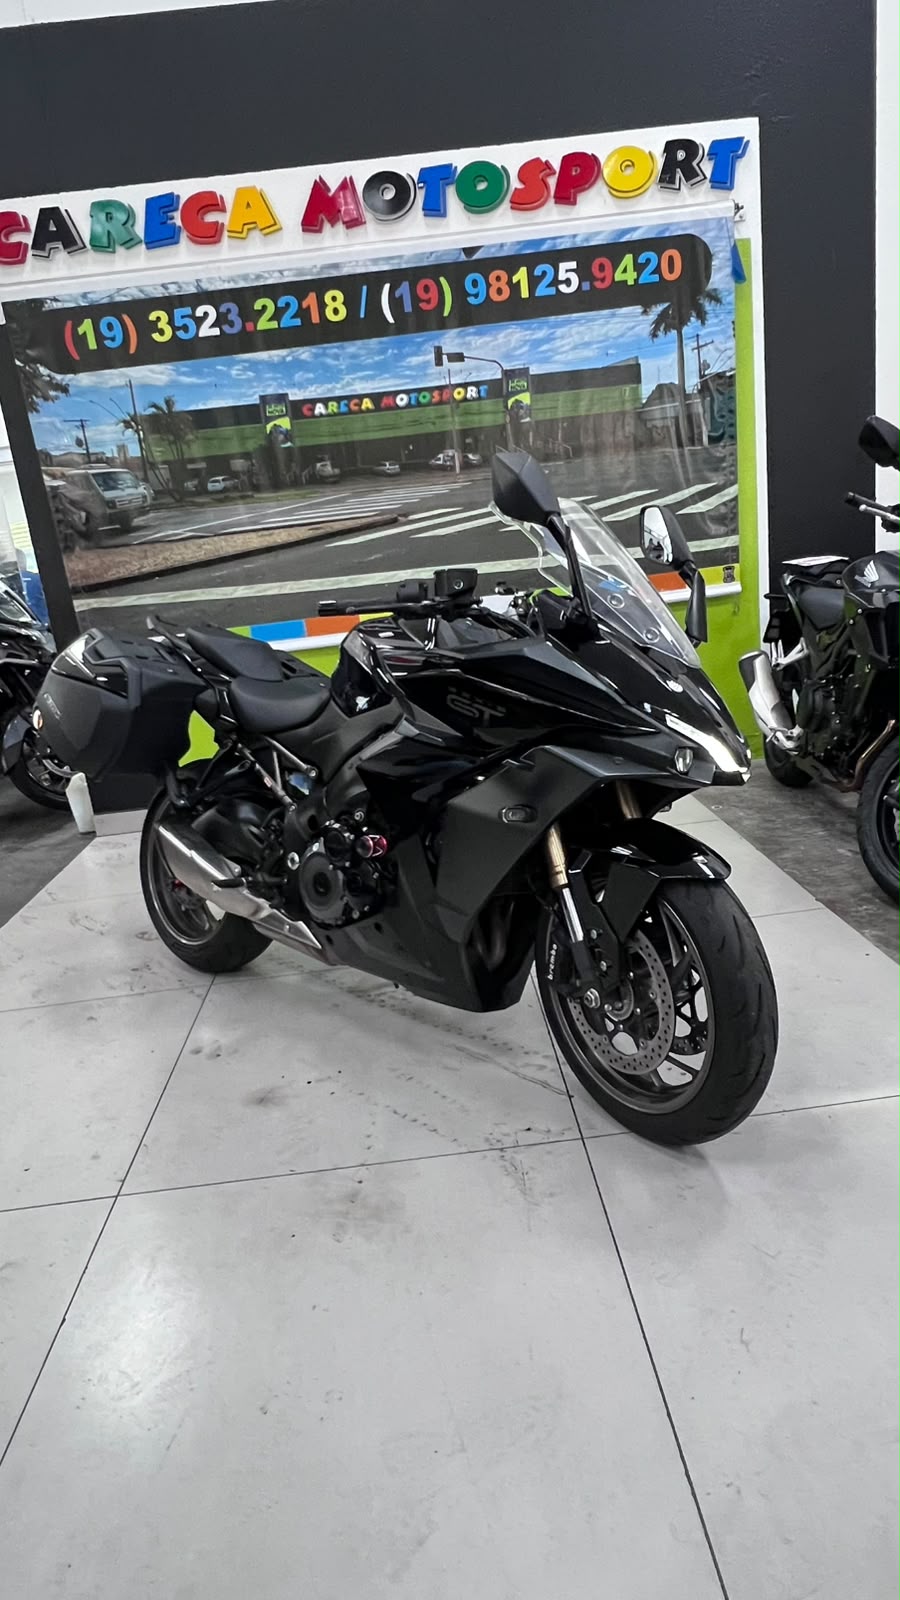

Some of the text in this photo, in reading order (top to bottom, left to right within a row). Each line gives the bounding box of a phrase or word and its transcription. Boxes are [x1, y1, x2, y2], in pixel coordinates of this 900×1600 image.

[0, 135, 750, 265] CARECA MOTOSPORT
[64, 248, 683, 360] (19) 3523.2218 / (19) 98125.9420
[302, 398, 375, 417] CARECA
[381, 385, 489, 408] MOTOSPORT
[546, 943, 558, 980] brembo
